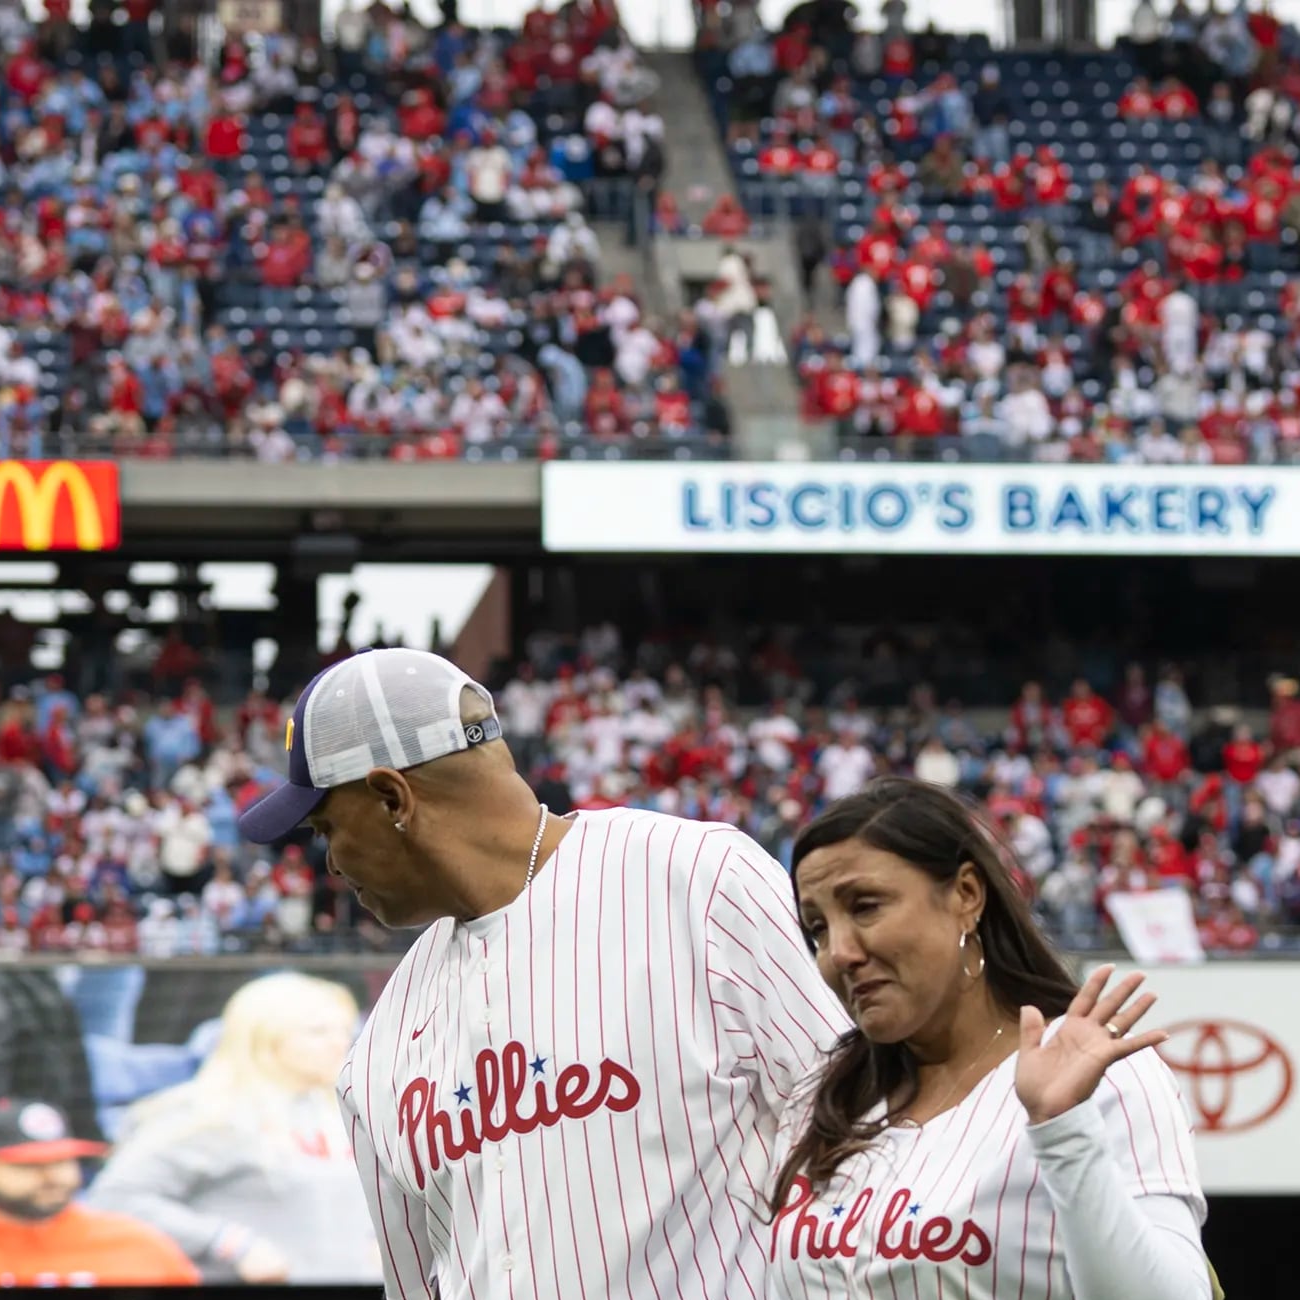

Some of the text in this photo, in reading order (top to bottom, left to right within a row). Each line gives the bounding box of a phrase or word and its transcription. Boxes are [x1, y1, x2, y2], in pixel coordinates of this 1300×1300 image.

[681, 482, 1278, 536] LISCIO'S BAKERY
[399, 1040, 641, 1191] Phillies
[770, 1174, 992, 1267] Phillies
